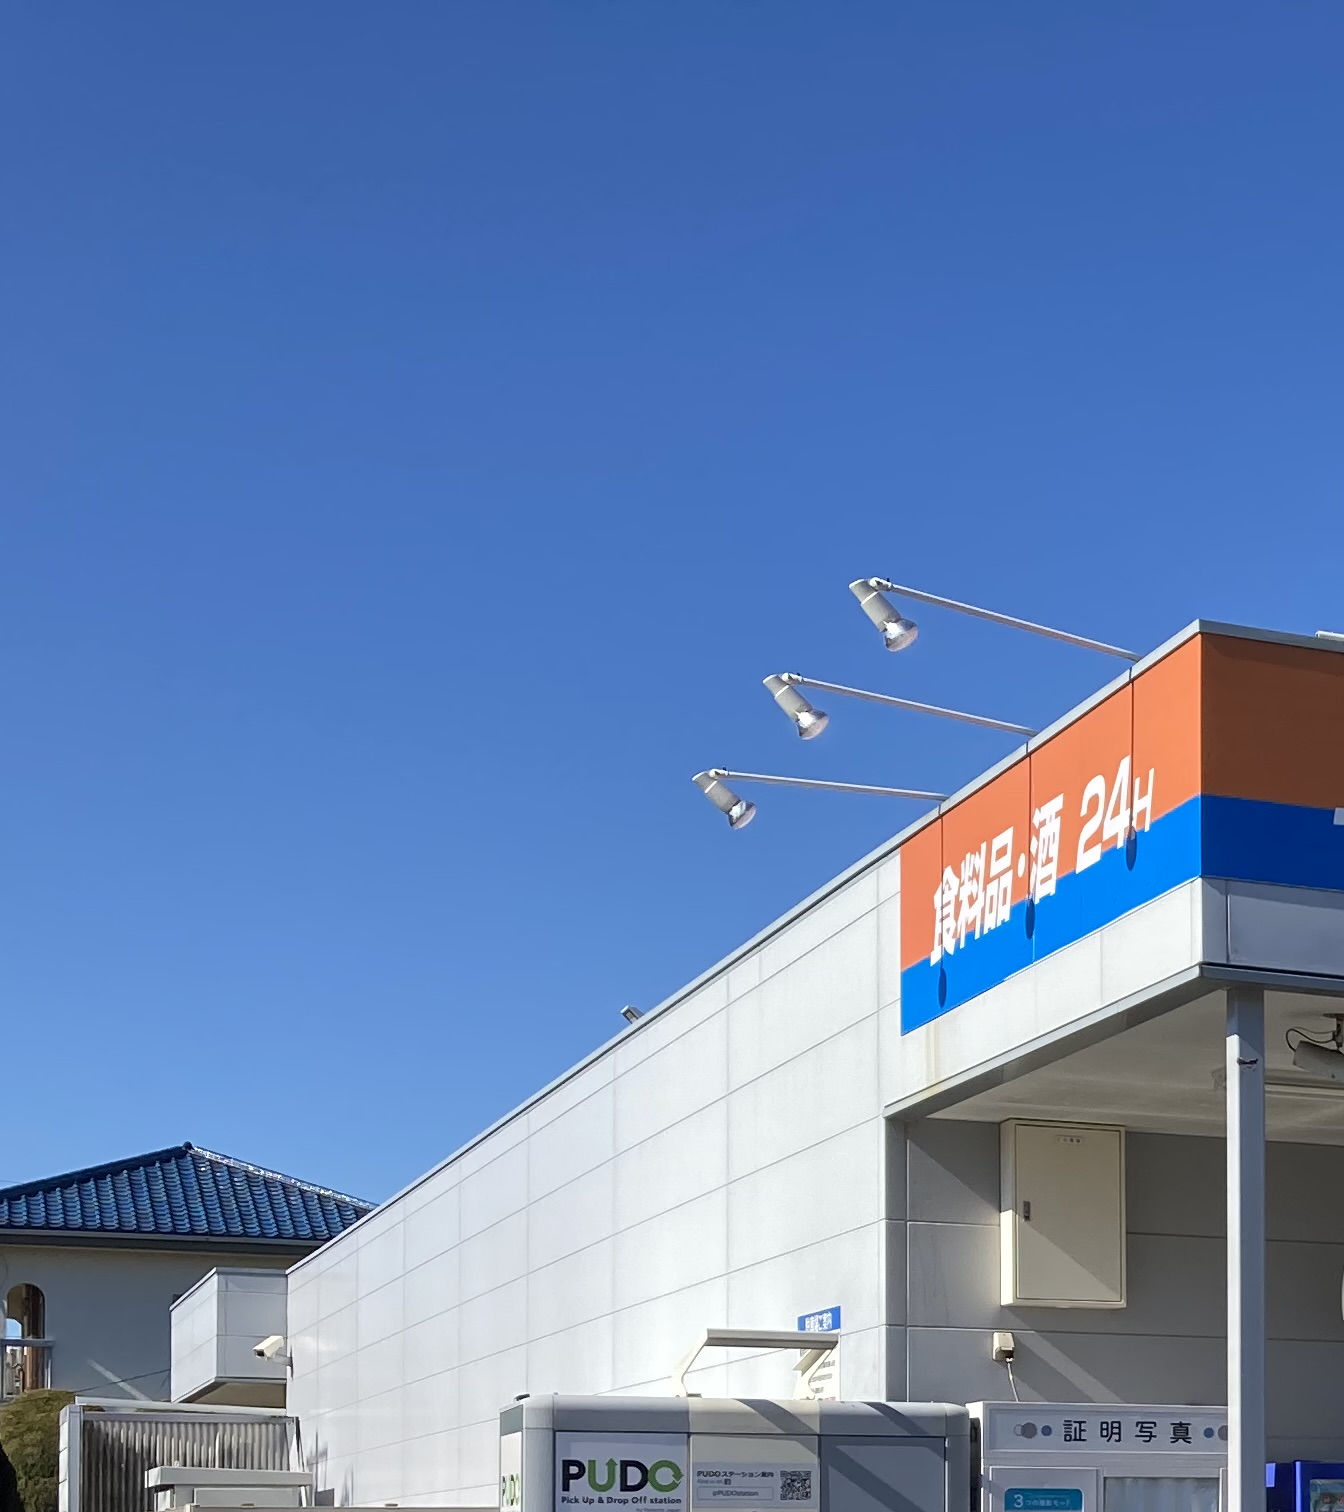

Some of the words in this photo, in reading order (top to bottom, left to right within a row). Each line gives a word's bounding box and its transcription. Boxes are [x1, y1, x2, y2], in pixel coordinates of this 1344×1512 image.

[929, 792, 1064, 967] 食料品・酒
[1075, 754, 1154, 875] 24H
[1062, 1419, 1193, 1445] 証明写真
[561, 1457, 685, 1493] PUDO
[561, 1496, 580, 1504] Pick
[581, 1497, 595, 1506] Up
[606, 1497, 629, 1506] Drop
[631, 1496, 648, 1504] Off
[649, 1497, 682, 1505] station
